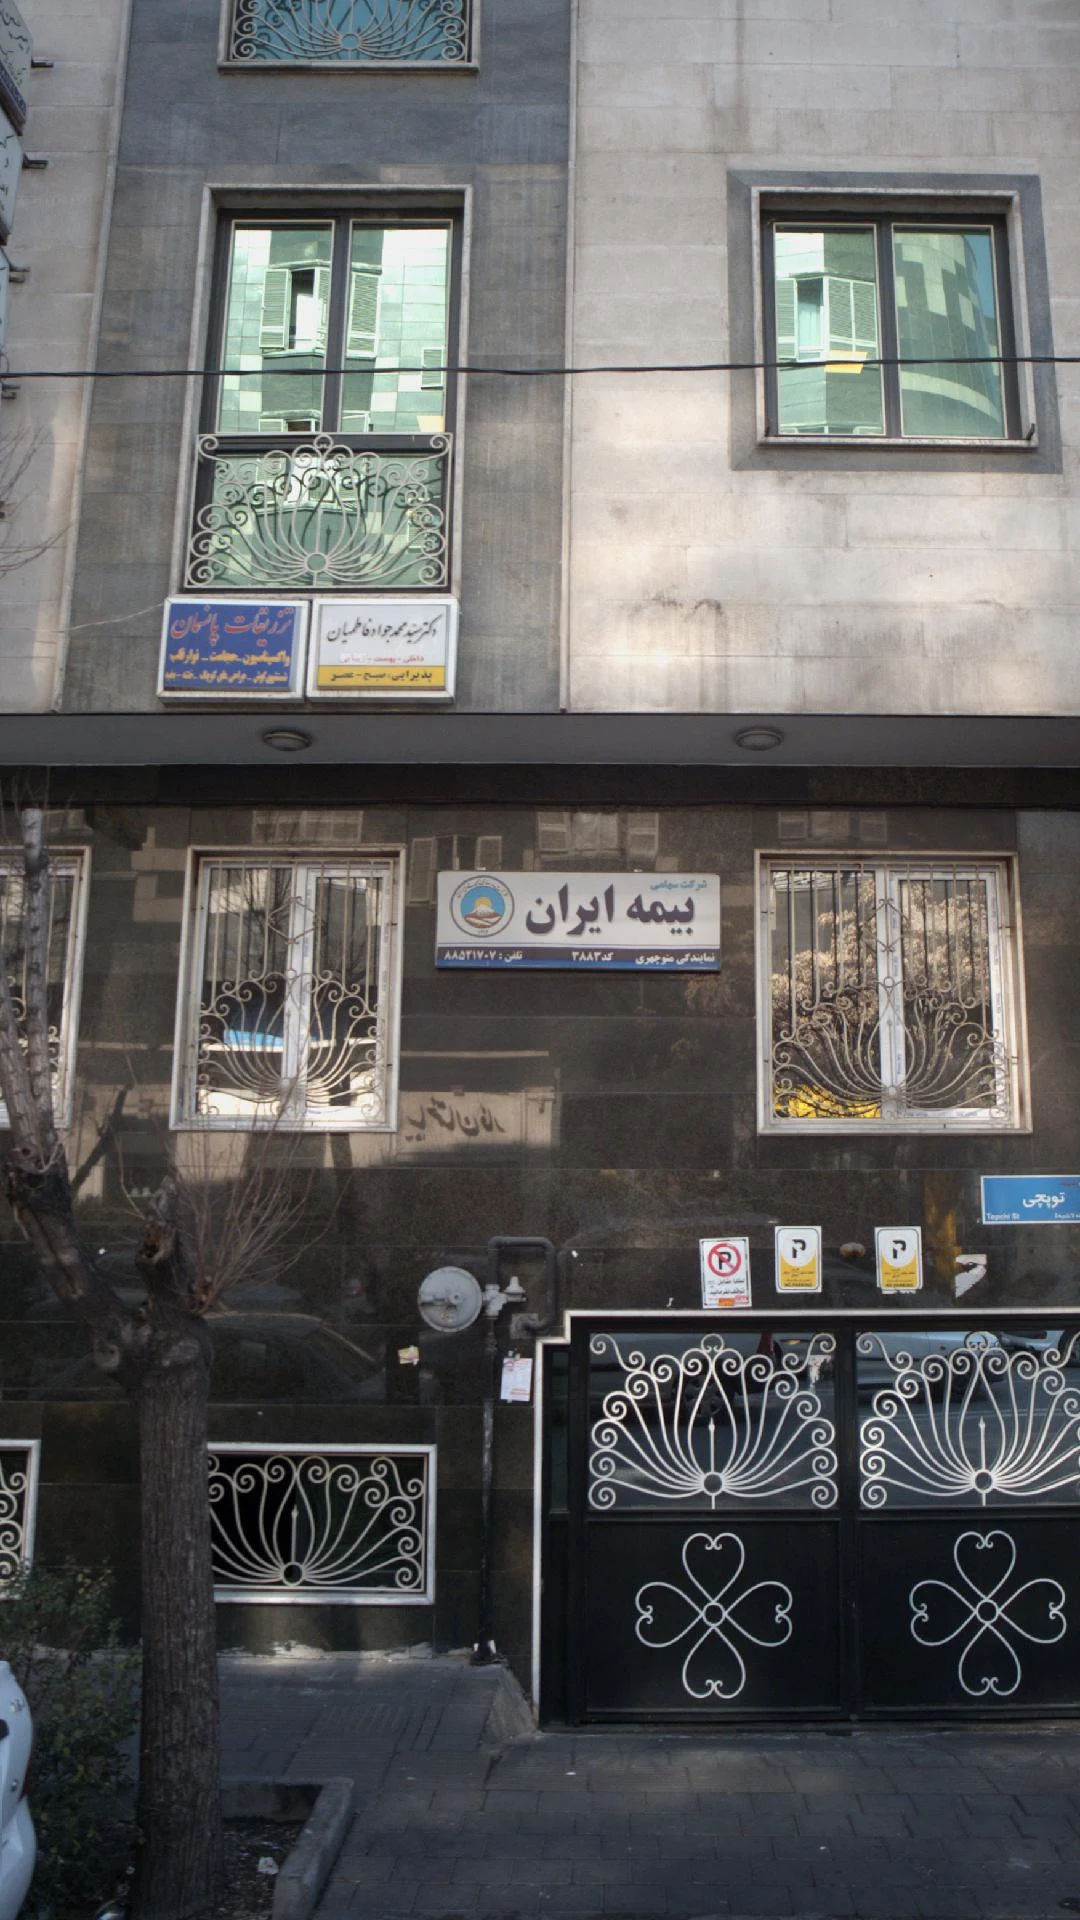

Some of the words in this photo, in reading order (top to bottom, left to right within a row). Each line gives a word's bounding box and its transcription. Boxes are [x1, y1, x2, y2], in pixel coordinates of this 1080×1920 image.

[414, 613, 443, 644] دکتر
[525, 882, 615, 936] ایران
[626, 893, 695, 936] بیمه
[1022, 1191, 1066, 1209] توپچی
